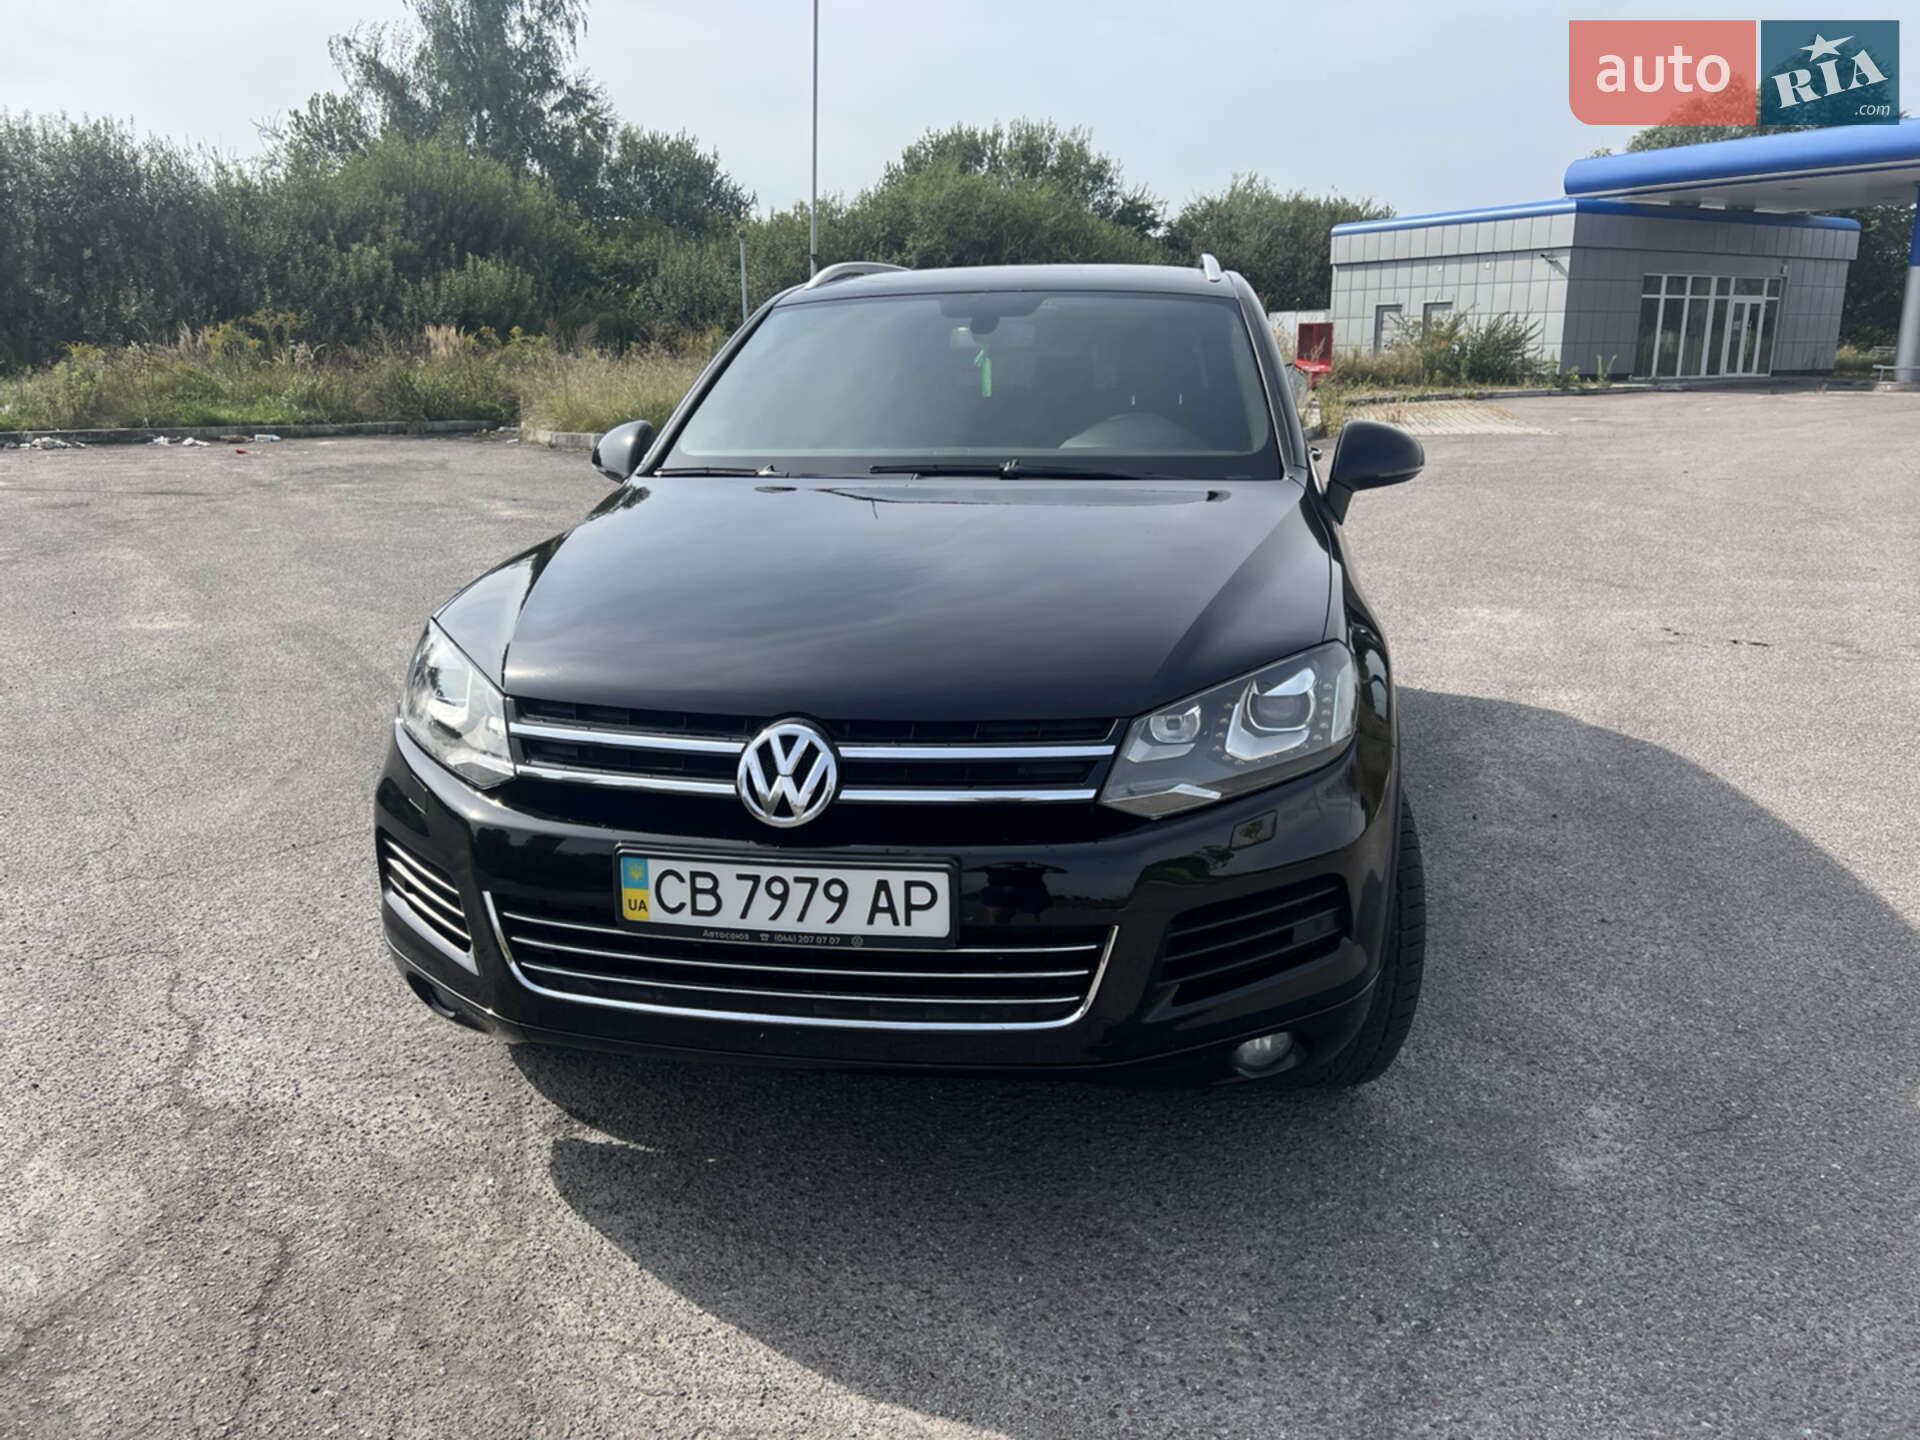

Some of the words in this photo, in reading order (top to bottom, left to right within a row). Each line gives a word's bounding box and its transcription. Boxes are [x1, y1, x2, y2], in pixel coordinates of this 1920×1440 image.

[627, 900, 648, 913] UA
[654, 869, 723, 918] CB
[735, 873, 849, 925] 7979
[866, 879, 939, 927] AP
[702, 928, 750, 941] Автосоюз
[798, 935, 814, 944] 207
[816, 936, 827, 945] 07
[829, 937, 841, 945] 07
